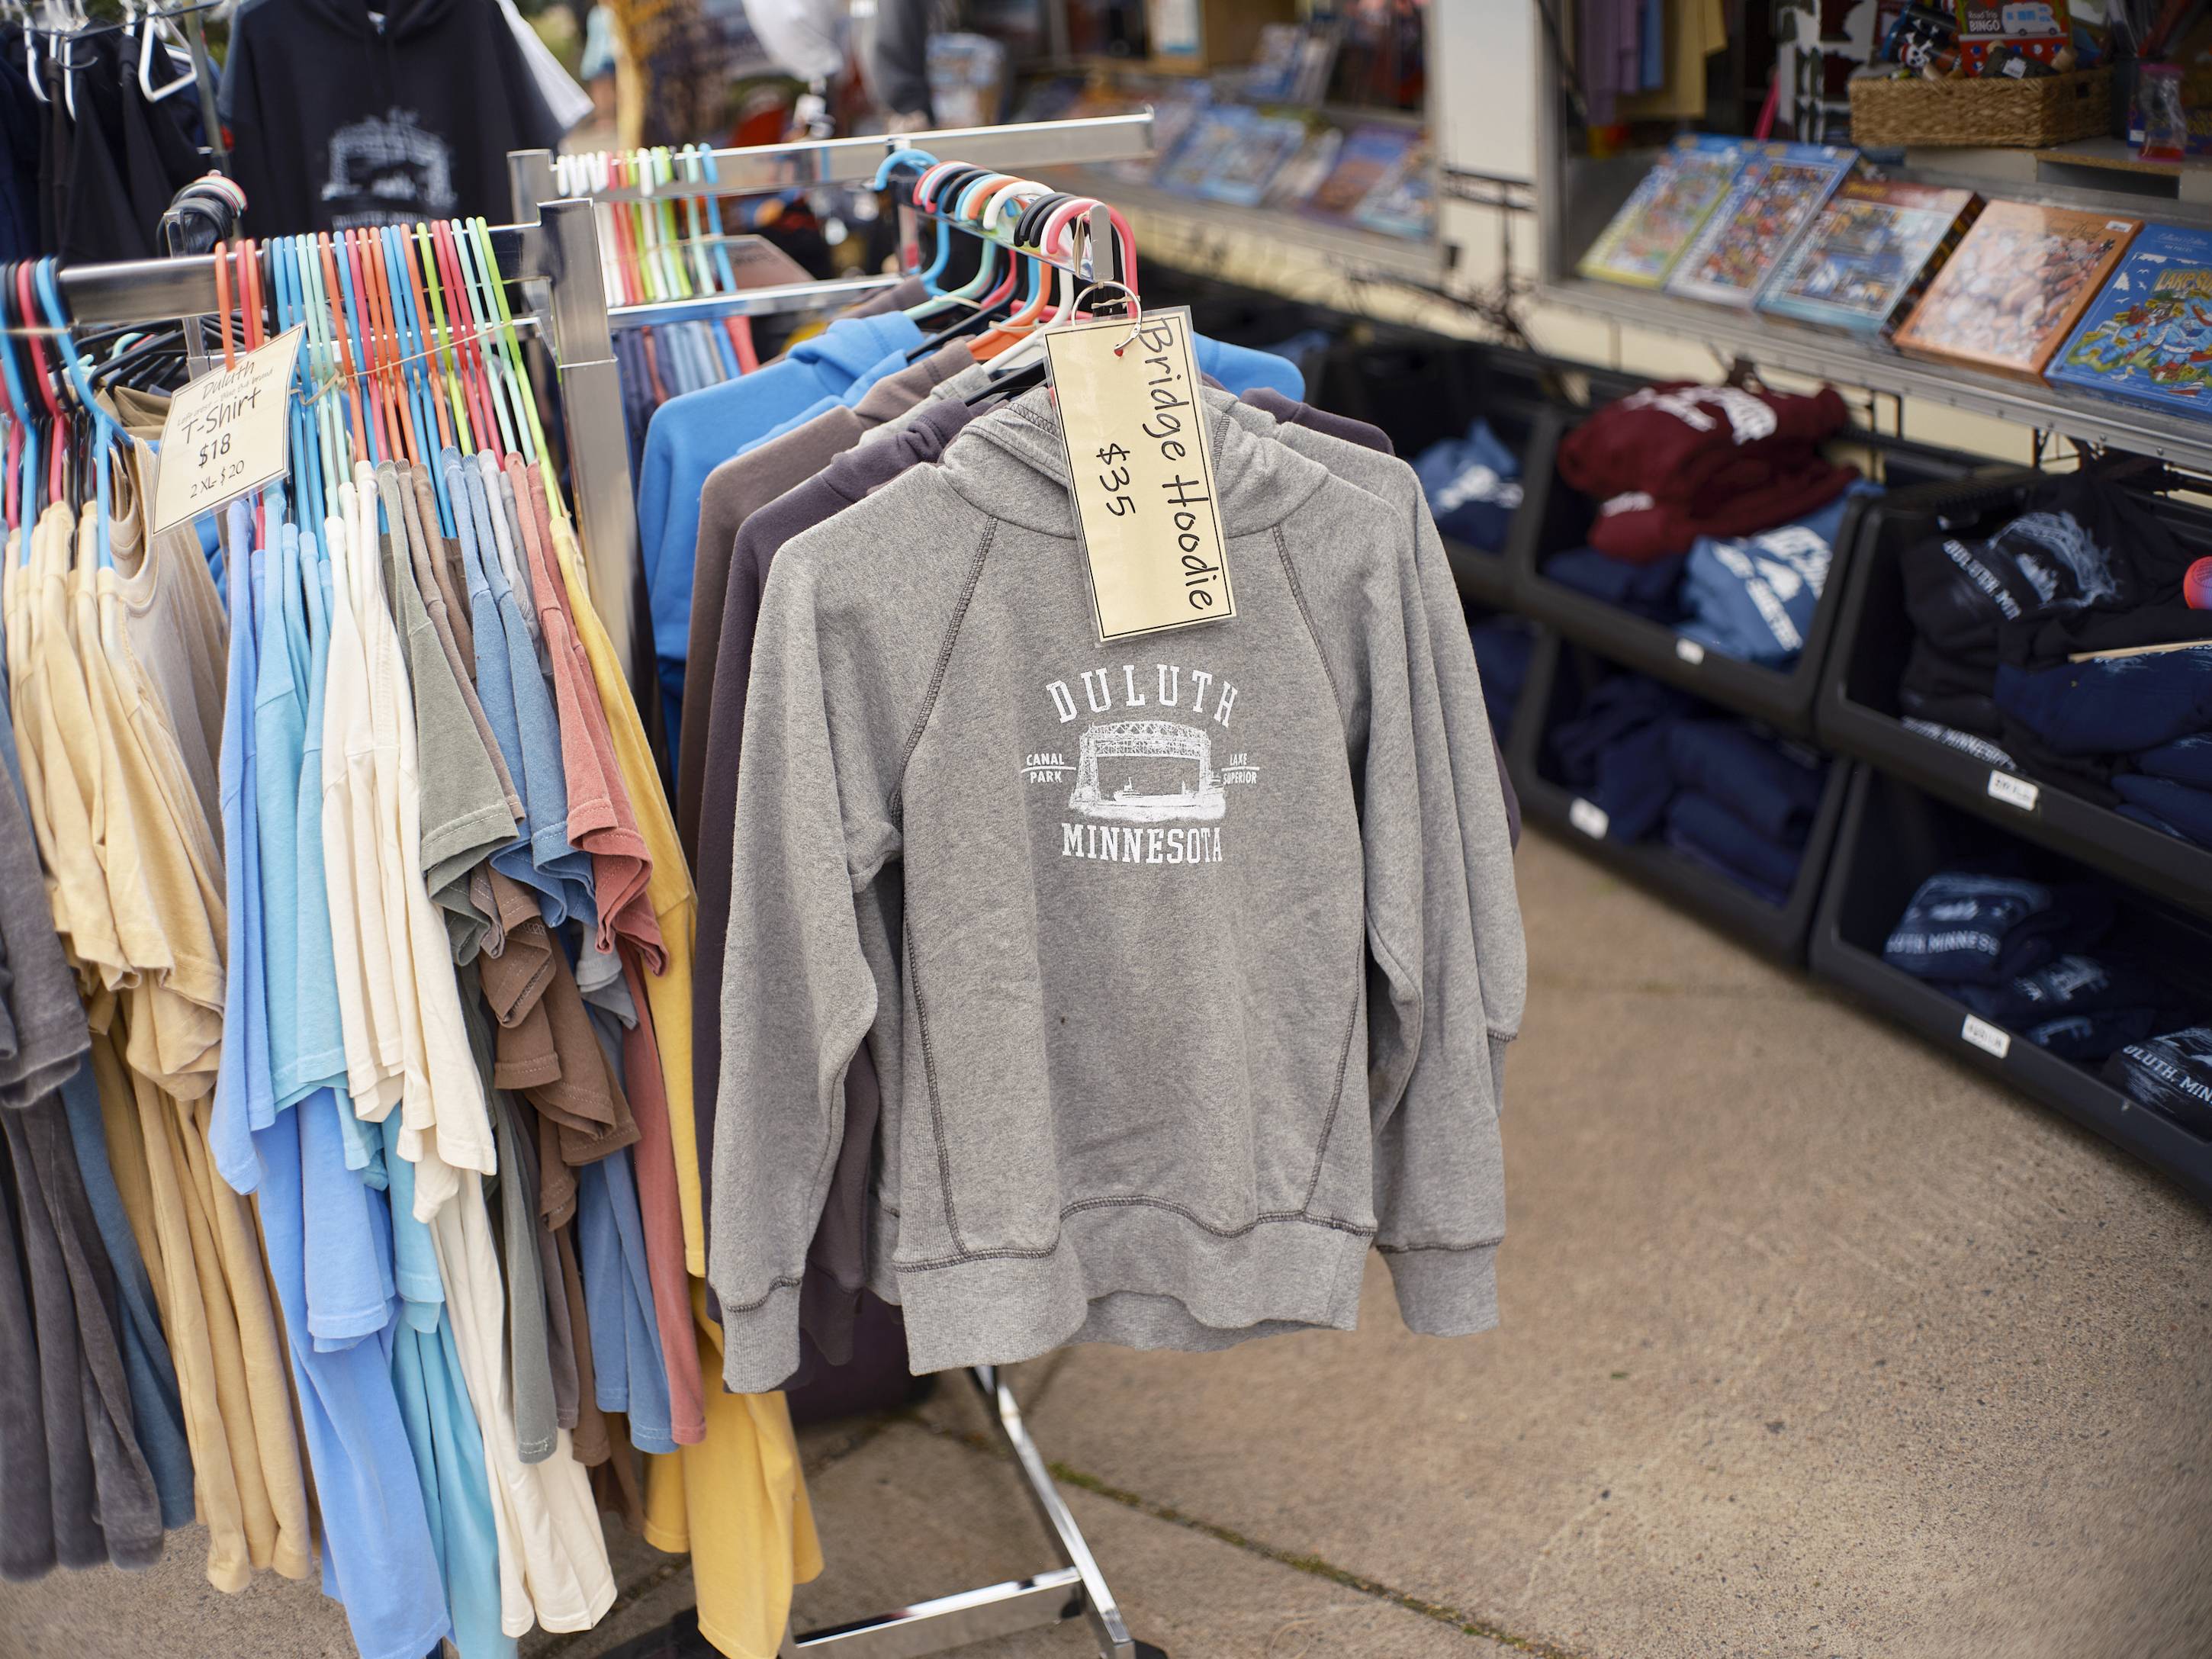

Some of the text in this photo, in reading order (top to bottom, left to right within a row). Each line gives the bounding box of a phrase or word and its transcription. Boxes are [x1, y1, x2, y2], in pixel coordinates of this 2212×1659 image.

[1969, 20, 2000, 31] BINGO
[202, 360, 254, 400] Duluth
[198, 432, 230, 468] $18
[1140, 317, 1219, 609] Bridge Hoodie
[1096, 443, 1135, 516] $35
[1046, 664, 1238, 728] DULUTH
[1026, 754, 1065, 767] CANAL
[1030, 770, 1063, 783] PARK
[1230, 753, 1248, 766] LAKE
[1223, 771, 1257, 785] SUPERIOR
[1061, 823, 1223, 863] MINNESOTA
